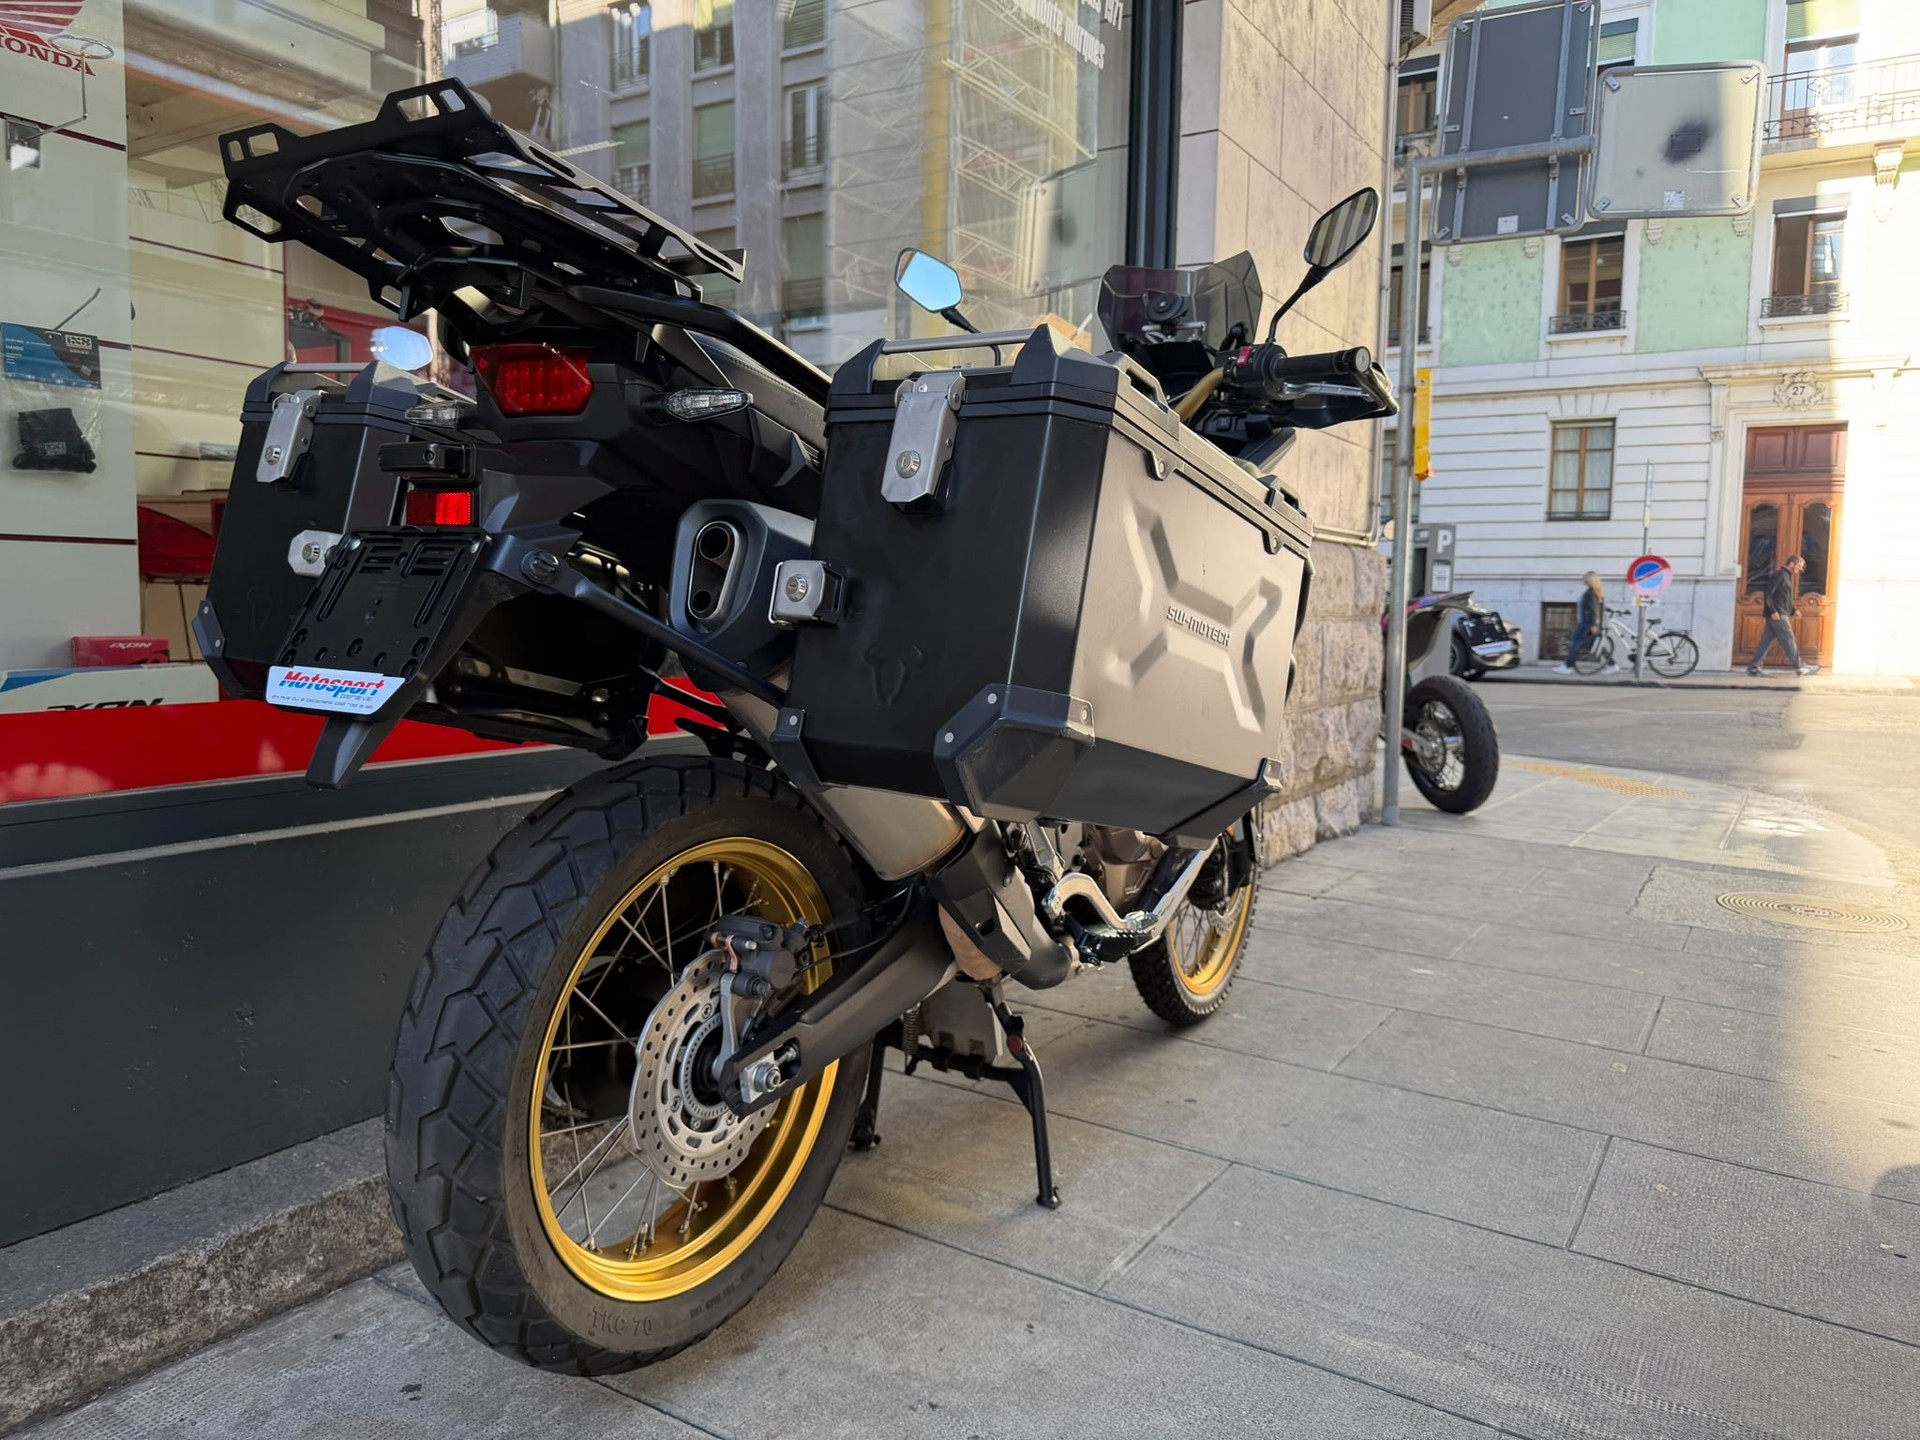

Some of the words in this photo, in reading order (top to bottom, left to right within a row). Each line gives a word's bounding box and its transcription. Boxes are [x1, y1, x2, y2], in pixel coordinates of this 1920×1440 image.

[0, 35, 96, 76] ONDA
[1064, 16, 1105, 69] marques
[1792, 386, 1806, 396] 27
[1437, 529, 1453, 553] P
[1166, 605, 1231, 648] SW-MOTECH
[279, 671, 385, 698] Motosport
[592, 1306, 625, 1335] TKC
[632, 1316, 652, 1336] 70
